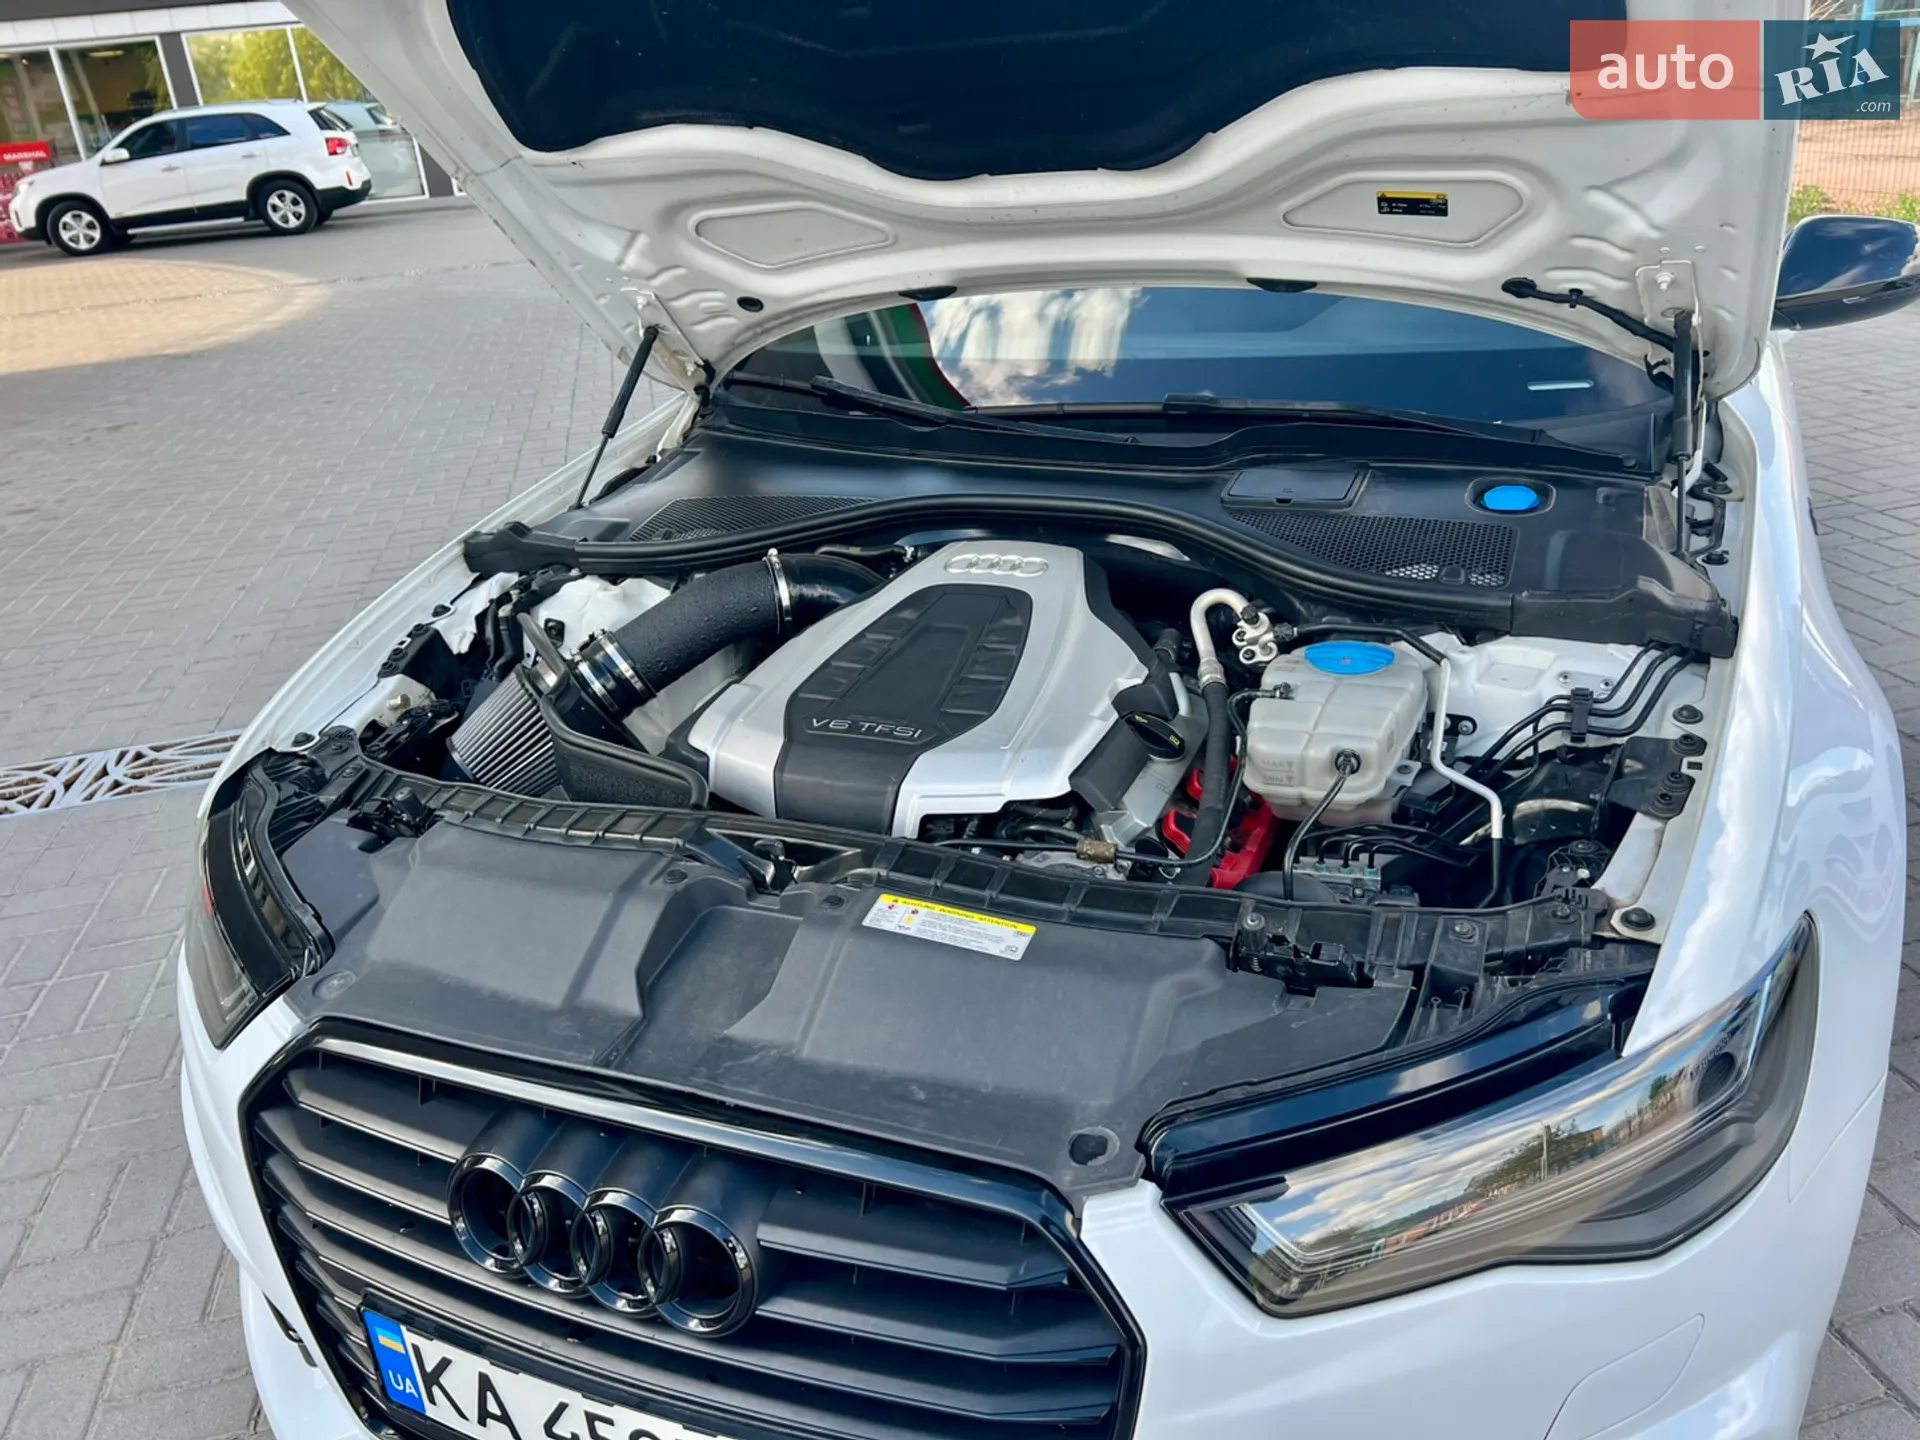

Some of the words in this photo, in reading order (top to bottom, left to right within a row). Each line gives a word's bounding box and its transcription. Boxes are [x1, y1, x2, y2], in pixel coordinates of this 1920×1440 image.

[3, 150, 47, 160] MARSHAL
[812, 718, 852, 730] V6
[858, 721, 923, 738] TFSI
[939, 908, 975, 919] WARNING
[978, 916, 1018, 928] ATTENTION
[388, 1369, 418, 1399] UA
[411, 1342, 523, 1440] KA
